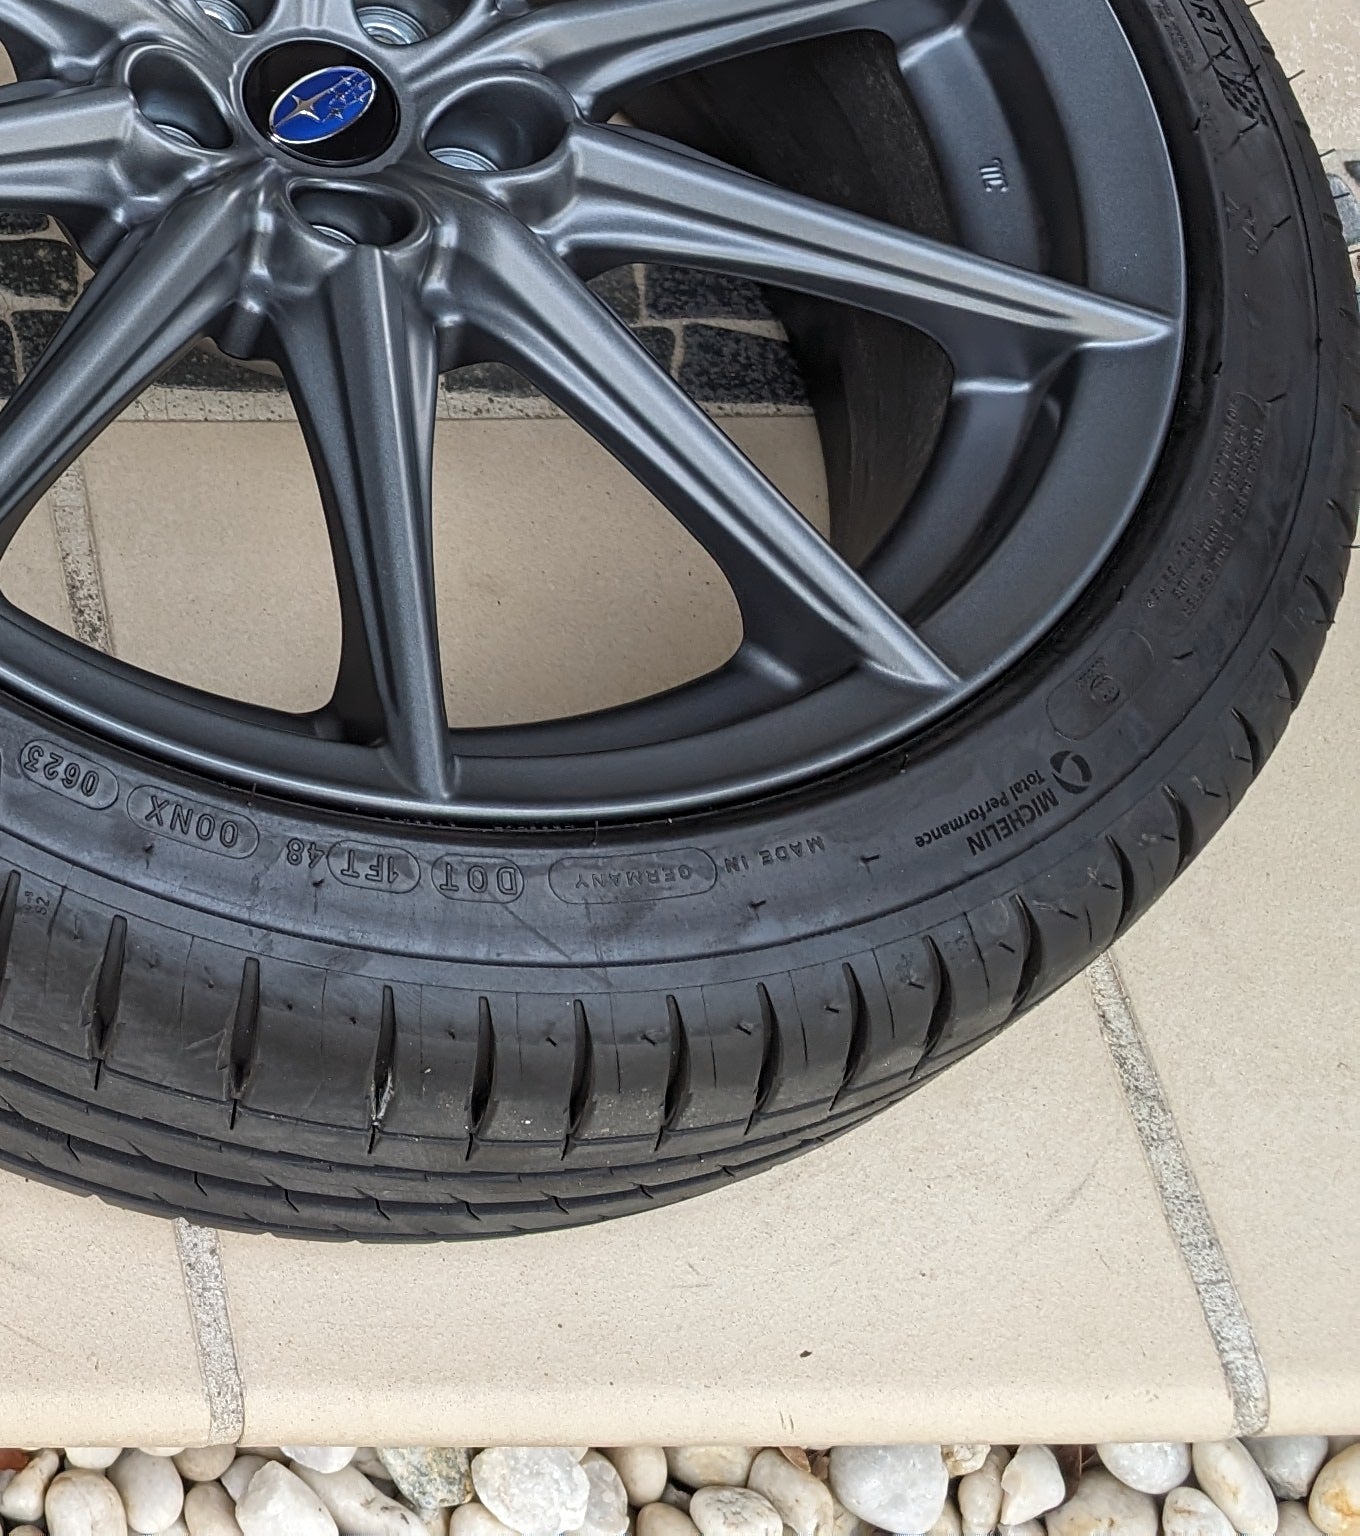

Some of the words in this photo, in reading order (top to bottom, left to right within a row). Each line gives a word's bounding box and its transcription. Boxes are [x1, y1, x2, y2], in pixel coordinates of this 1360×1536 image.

[16, 745, 102, 804] 0623
[1003, 768, 1049, 801] Total
[140, 794, 242, 851] 00NX
[908, 789, 1016, 851] Performance
[956, 786, 1067, 856] MICHELIN
[283, 835, 324, 869] 48
[340, 848, 398, 884] 1FT
[720, 853, 752, 874] IN
[755, 833, 828, 866] MADE
[437, 861, 522, 894] DOT
[571, 860, 694, 890] GERMANY
